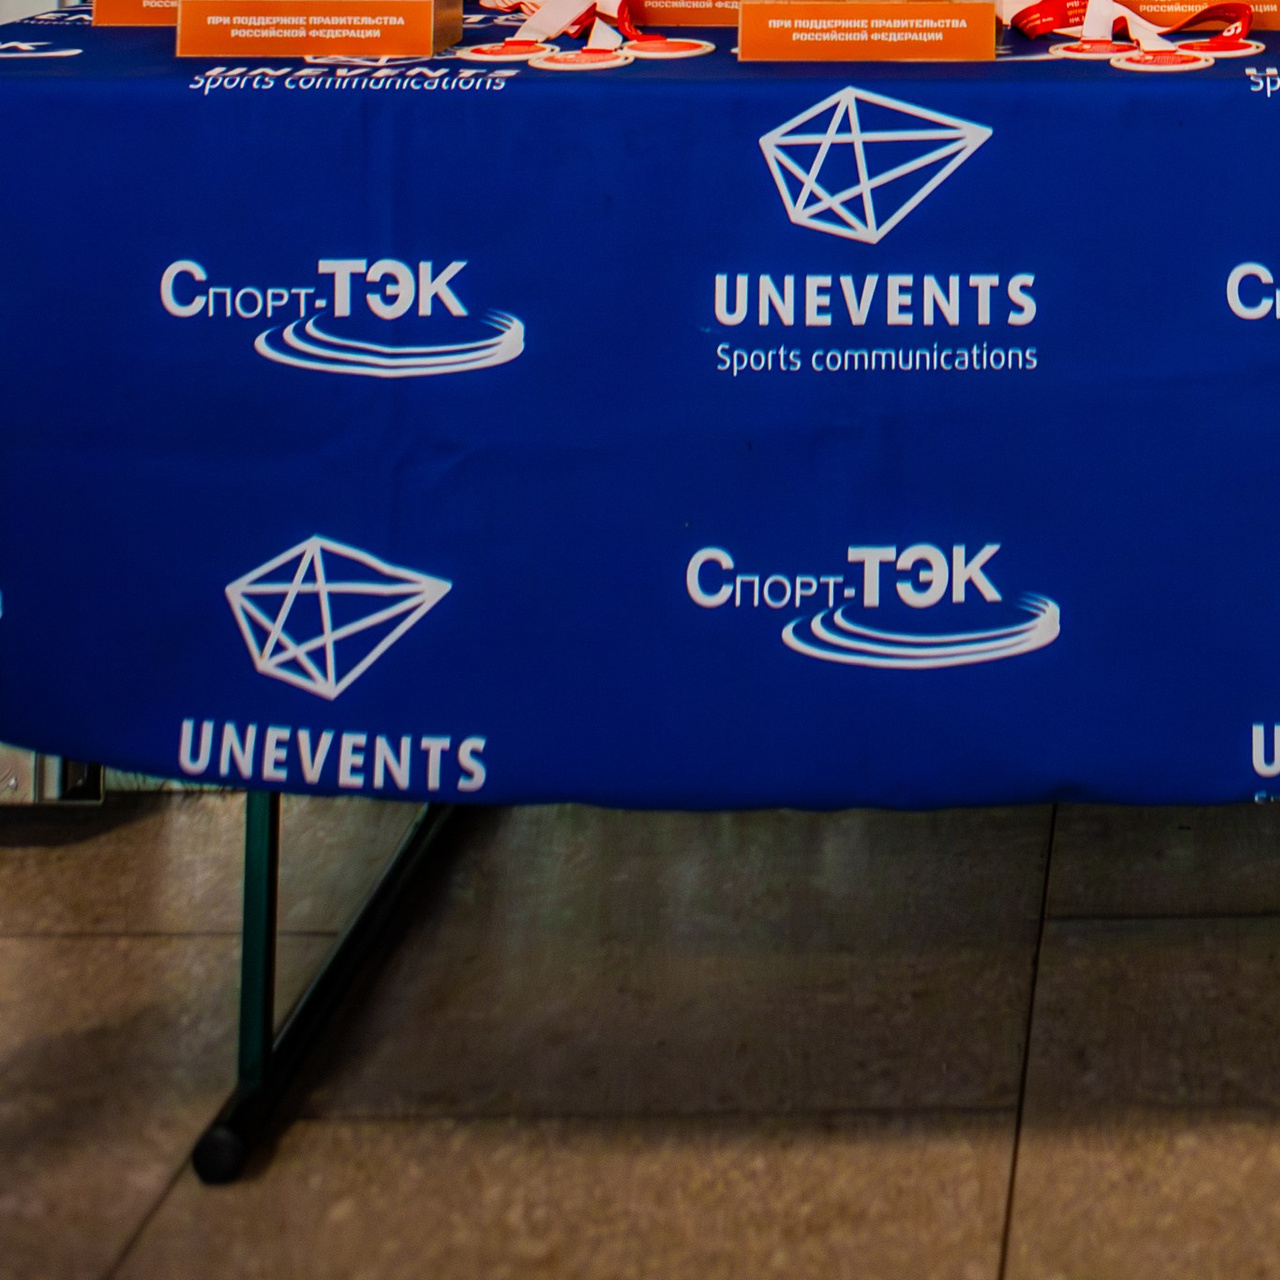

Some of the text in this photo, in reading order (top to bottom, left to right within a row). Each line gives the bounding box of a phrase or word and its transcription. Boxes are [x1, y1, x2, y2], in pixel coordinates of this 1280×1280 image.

[206, 15, 405, 27] ПРИ ПОДДЕРЖКЕ ПРАВИТЕЛЬСТВА
[768, 18, 968, 30] ПРИ ПОДДЕРЖКЕ ПРАВИТЕЛЬСТВА
[230, 26, 381, 39] РОССИЙСКОЙ ФЕДЕРАЦИИ
[792, 30, 944, 43] РОССИЙСКОЙ ФЕДЕРАЦИИ
[714, 273, 1038, 328] UNEVENTS
[716, 342, 1038, 376] Sports communications
[178, 718, 488, 793] UNEVENTS
